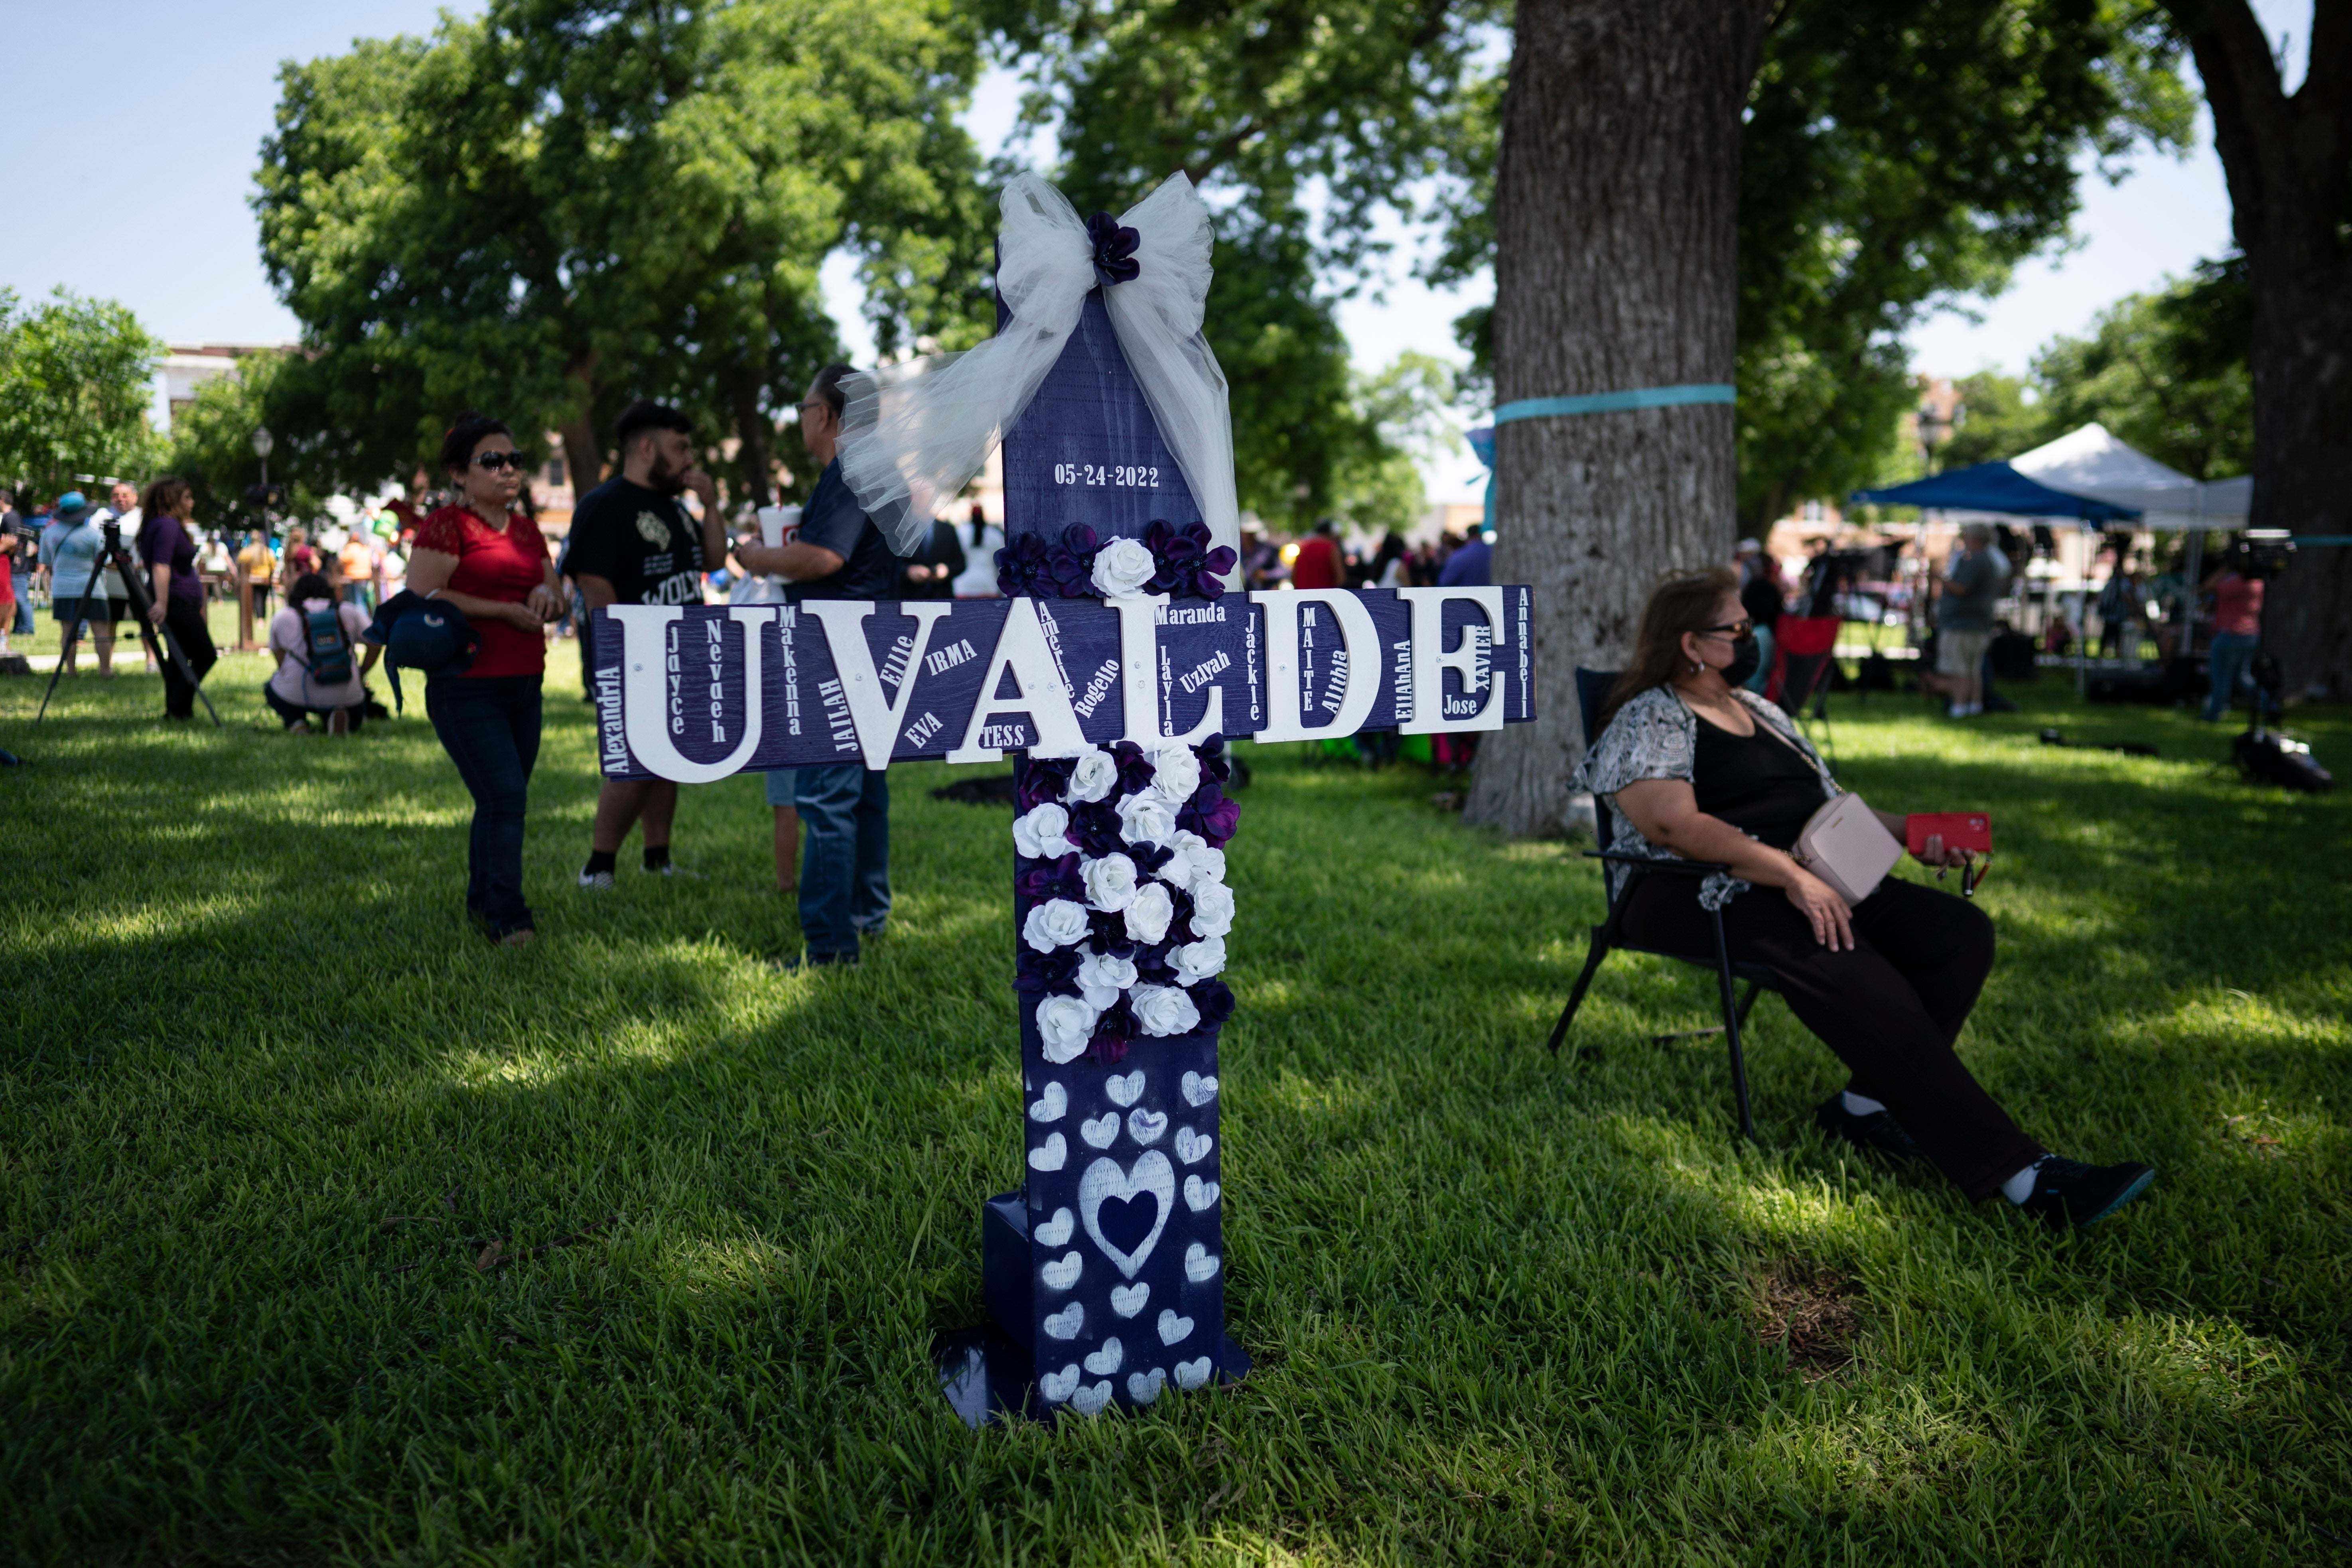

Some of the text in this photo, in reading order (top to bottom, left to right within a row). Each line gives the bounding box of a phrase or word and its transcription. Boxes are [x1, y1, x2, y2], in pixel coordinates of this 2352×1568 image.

[1055, 463, 1159, 487] 05-24-2022
[1155, 602, 1226, 625] Maranda
[705, 619, 727, 743] Nevaeh
[779, 606, 801, 736] Makenna
[879, 636, 914, 687] Ellie
[925, 638, 978, 676] IRMA
[1038, 601, 1075, 699] Amerie
[1179, 650, 1231, 693] Uziyah
[1245, 613, 1260, 721] Jackie
[1303, 607, 1316, 711] MAITE
[1321, 650, 1348, 714] Alithia
[1475, 625, 1491, 691] XAVIER
[1518, 587, 1529, 718] Annabell
[607, 585, 1505, 783] UVALDE
[818, 678, 858, 752] JAILAH
[1074, 659, 1120, 719] Rogelio
[1160, 646, 1174, 737] Layla
[1444, 694, 1477, 715] Jose
[904, 711, 943, 749] EVA
[981, 725, 1025, 747] TESS
